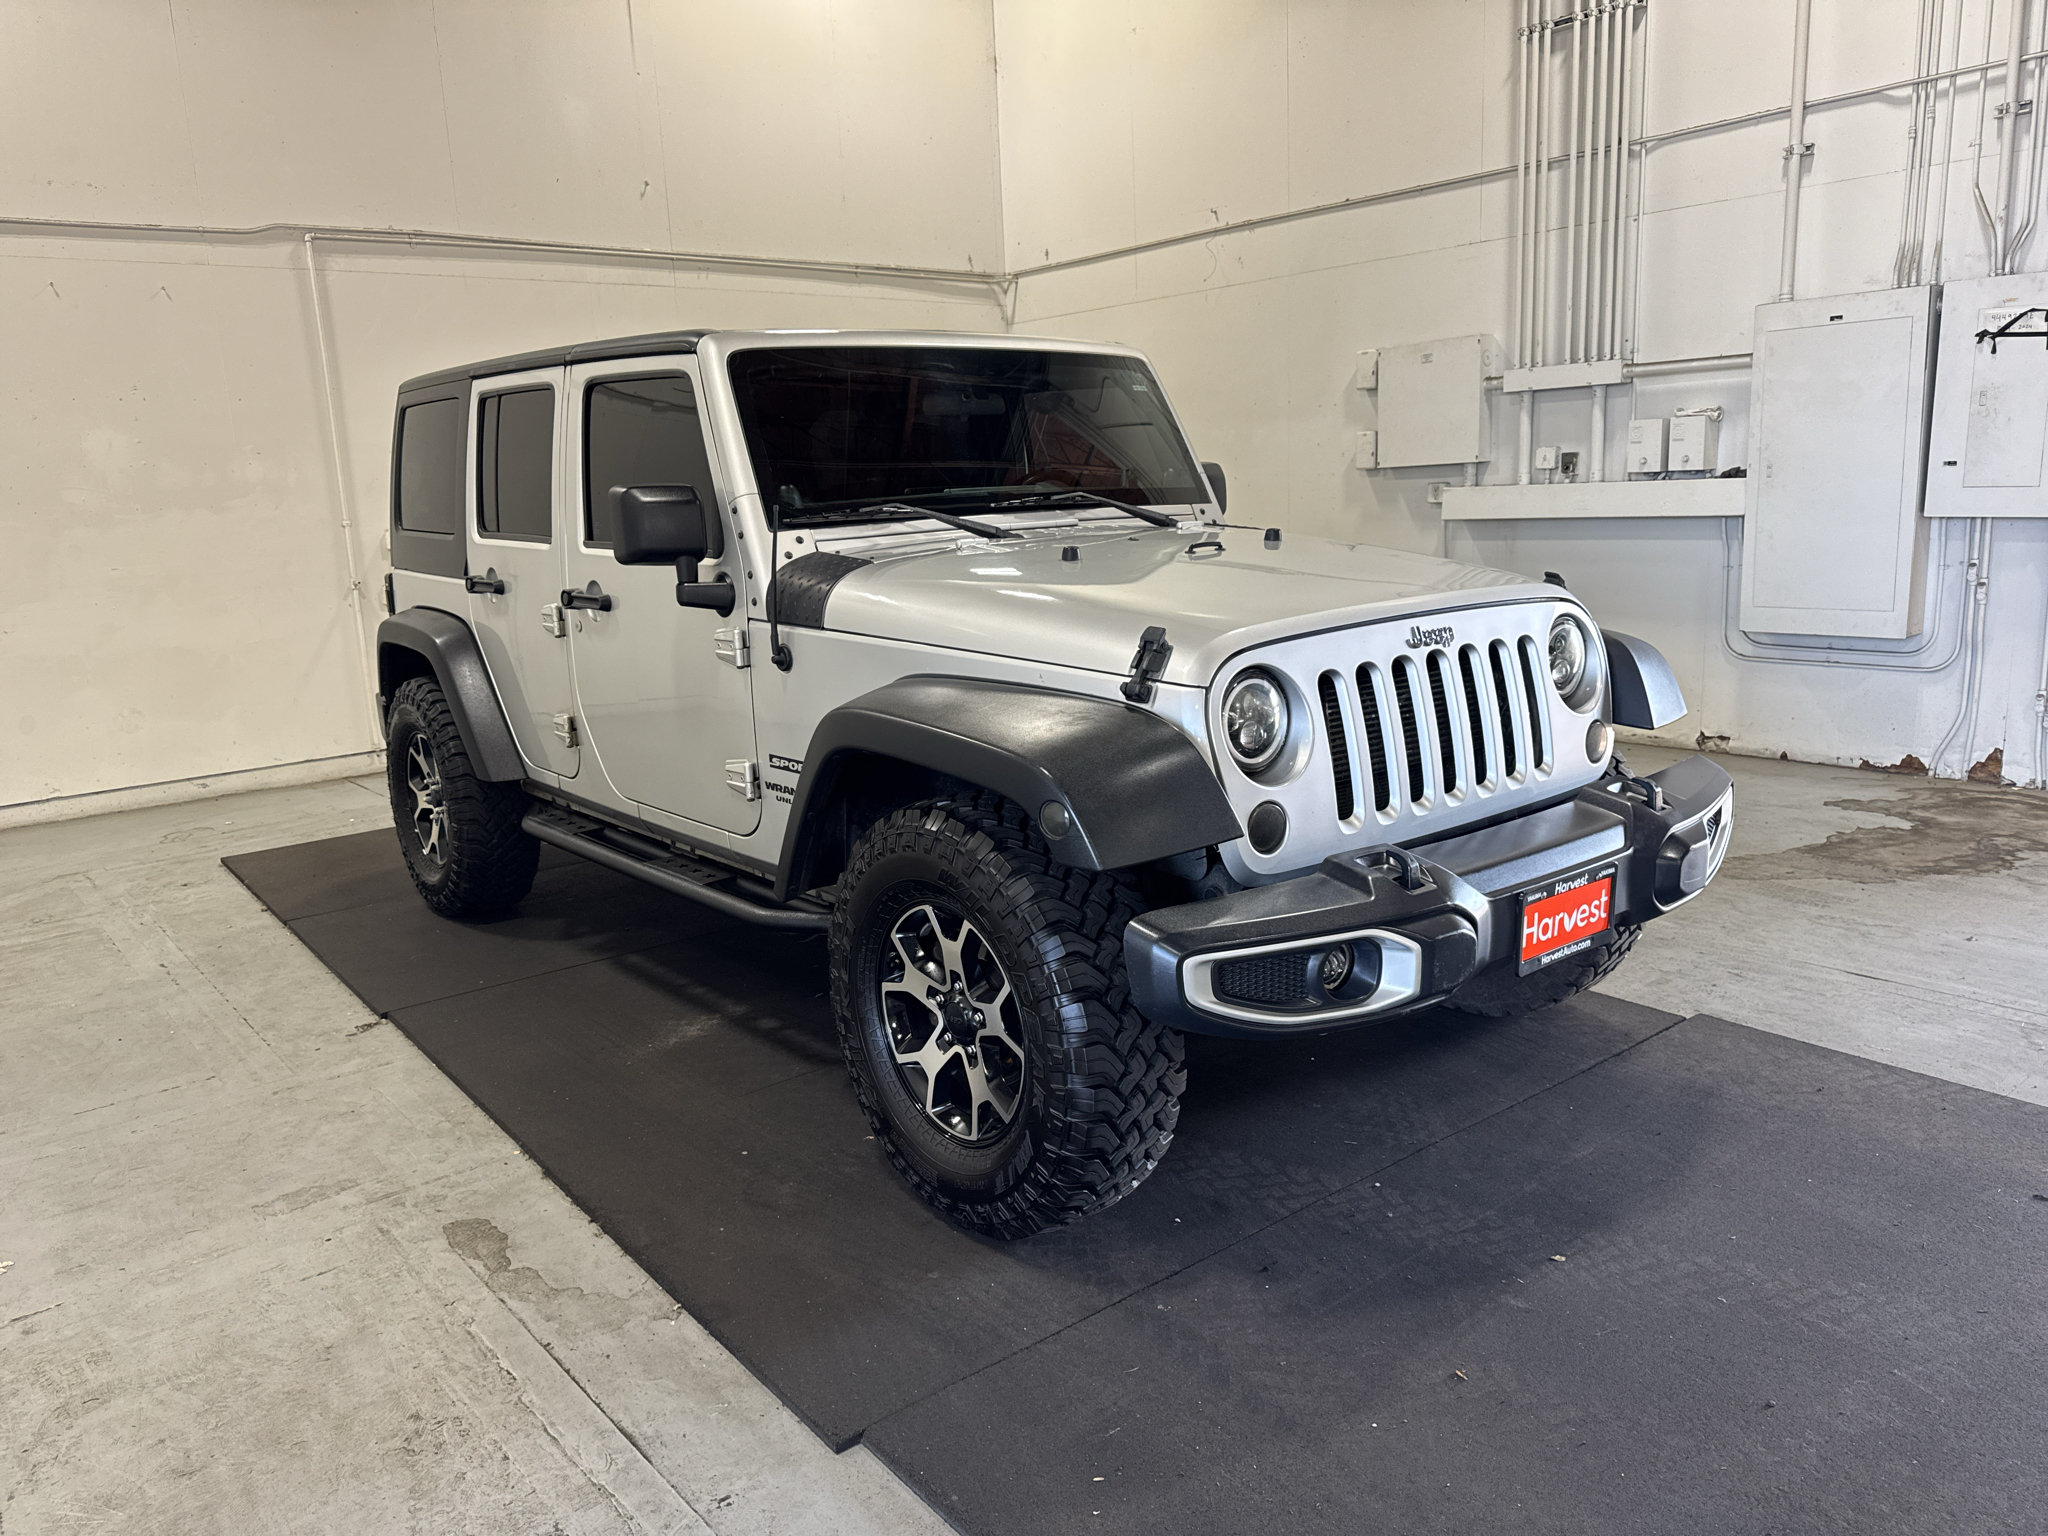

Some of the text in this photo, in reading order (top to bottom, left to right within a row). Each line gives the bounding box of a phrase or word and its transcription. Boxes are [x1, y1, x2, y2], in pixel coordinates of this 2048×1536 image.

[1405, 625, 1455, 649] Jeep
[1554, 873, 1589, 896] Harvest
[1522, 889, 1609, 949] Harvest
[1541, 939, 1592, 965] HarvestAuto.com
